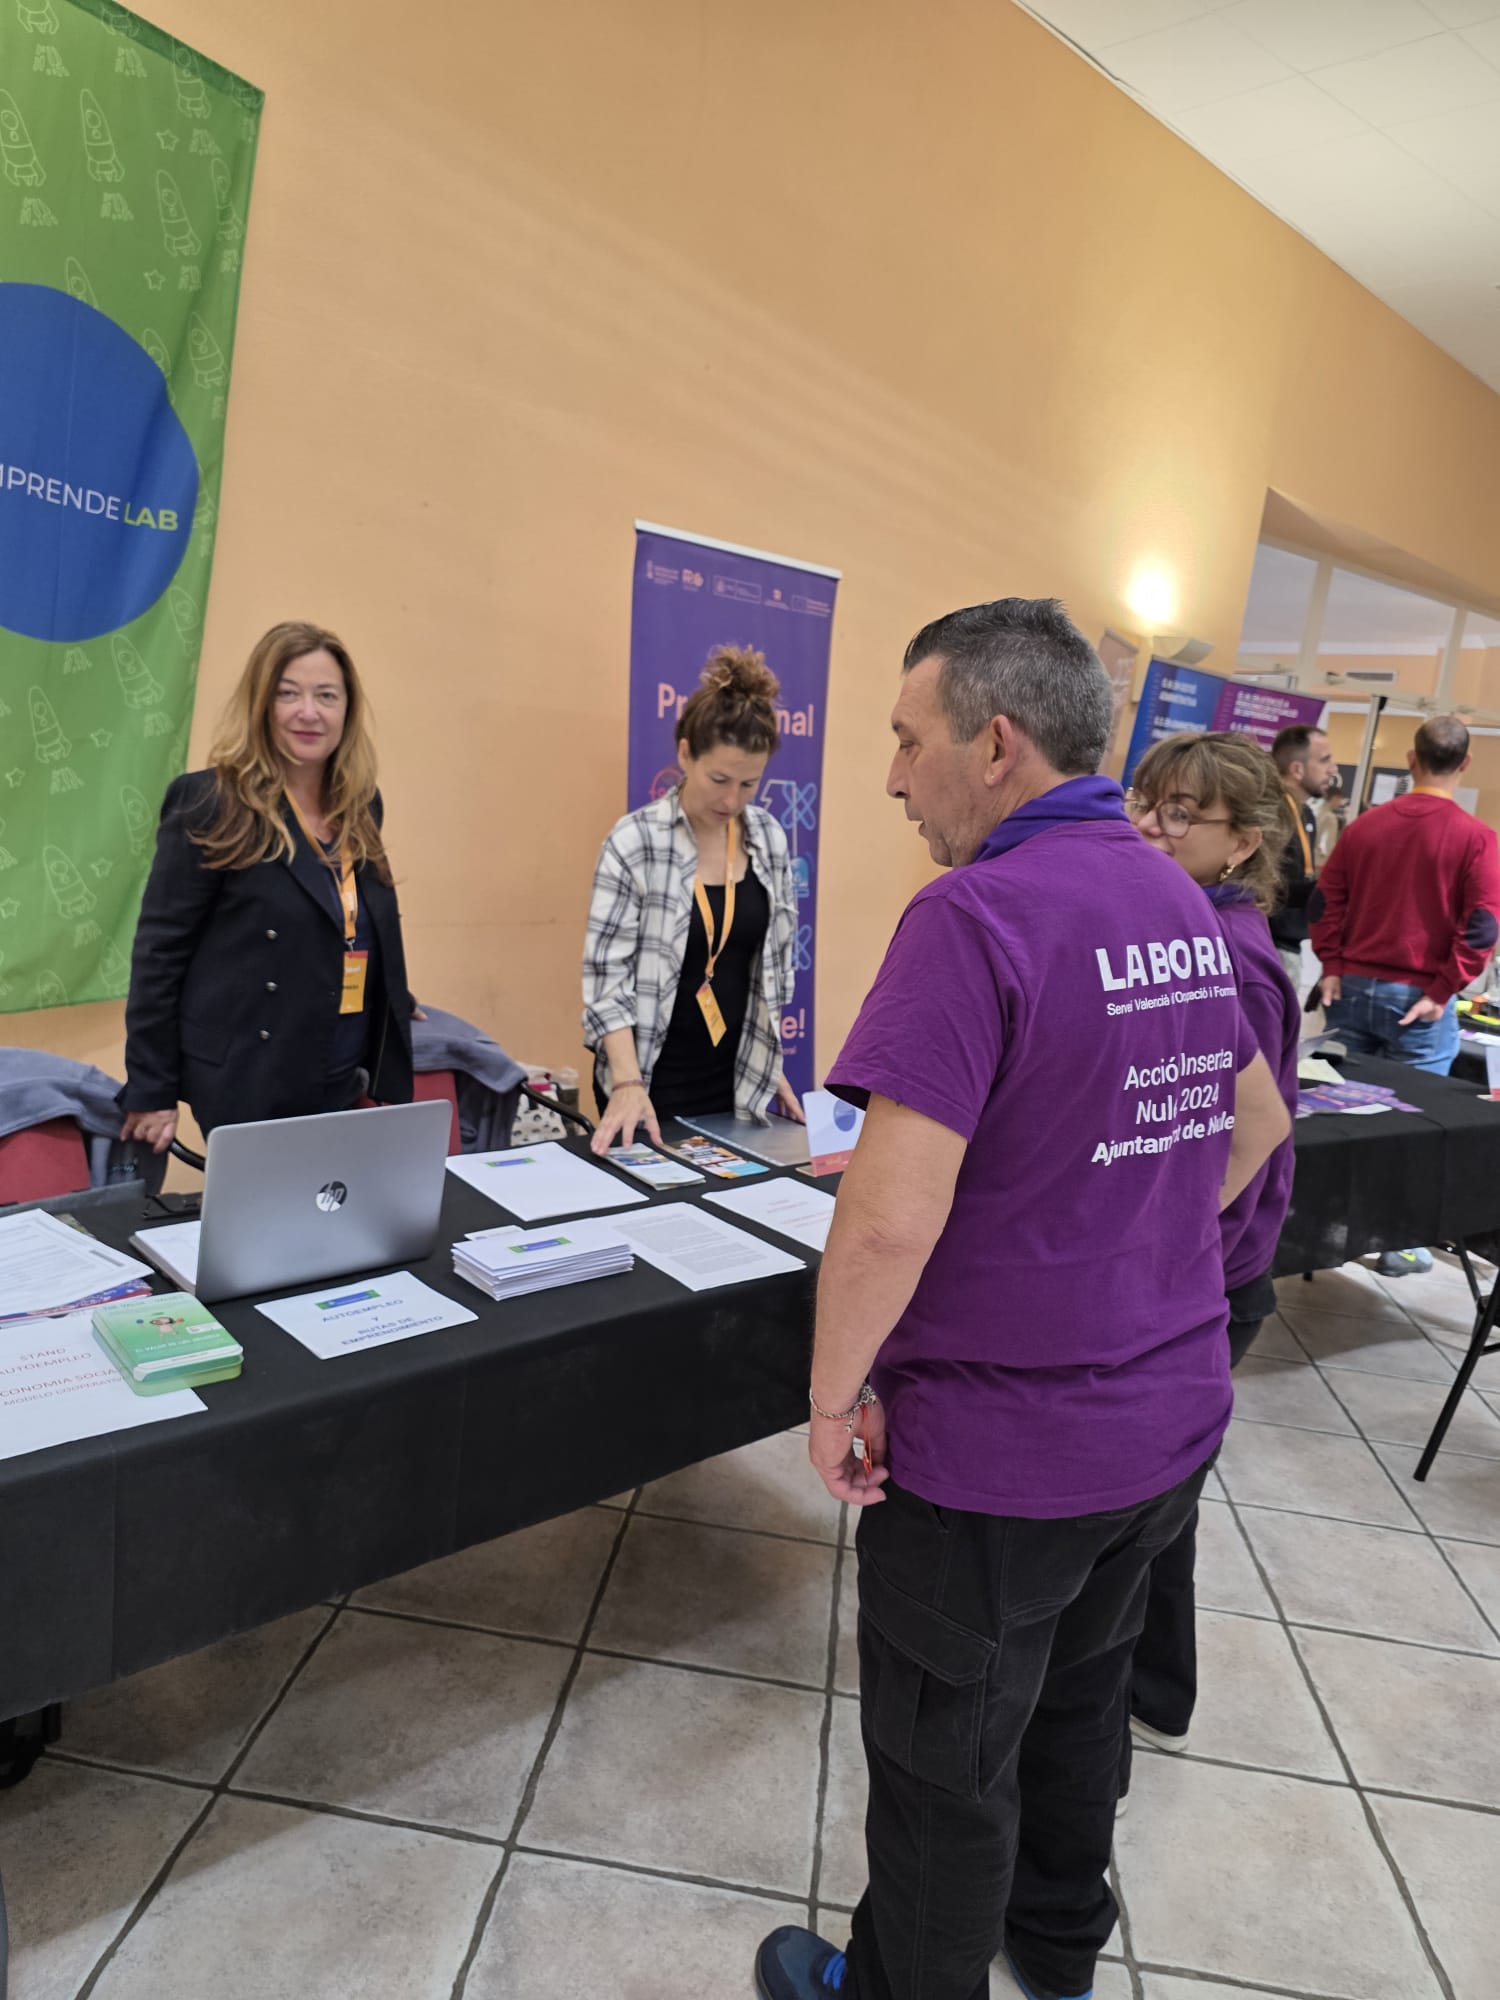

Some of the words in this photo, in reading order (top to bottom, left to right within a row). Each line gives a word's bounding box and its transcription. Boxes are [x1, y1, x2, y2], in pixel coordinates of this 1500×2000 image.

[1123, 1056, 1179, 1091] Acció
[1135, 1095, 1178, 1124] Nul
[1179, 1082, 1219, 1112] 2024
[1182, 1118, 1206, 1140] de
[0, 1377, 73, 1397] CONOMIA
